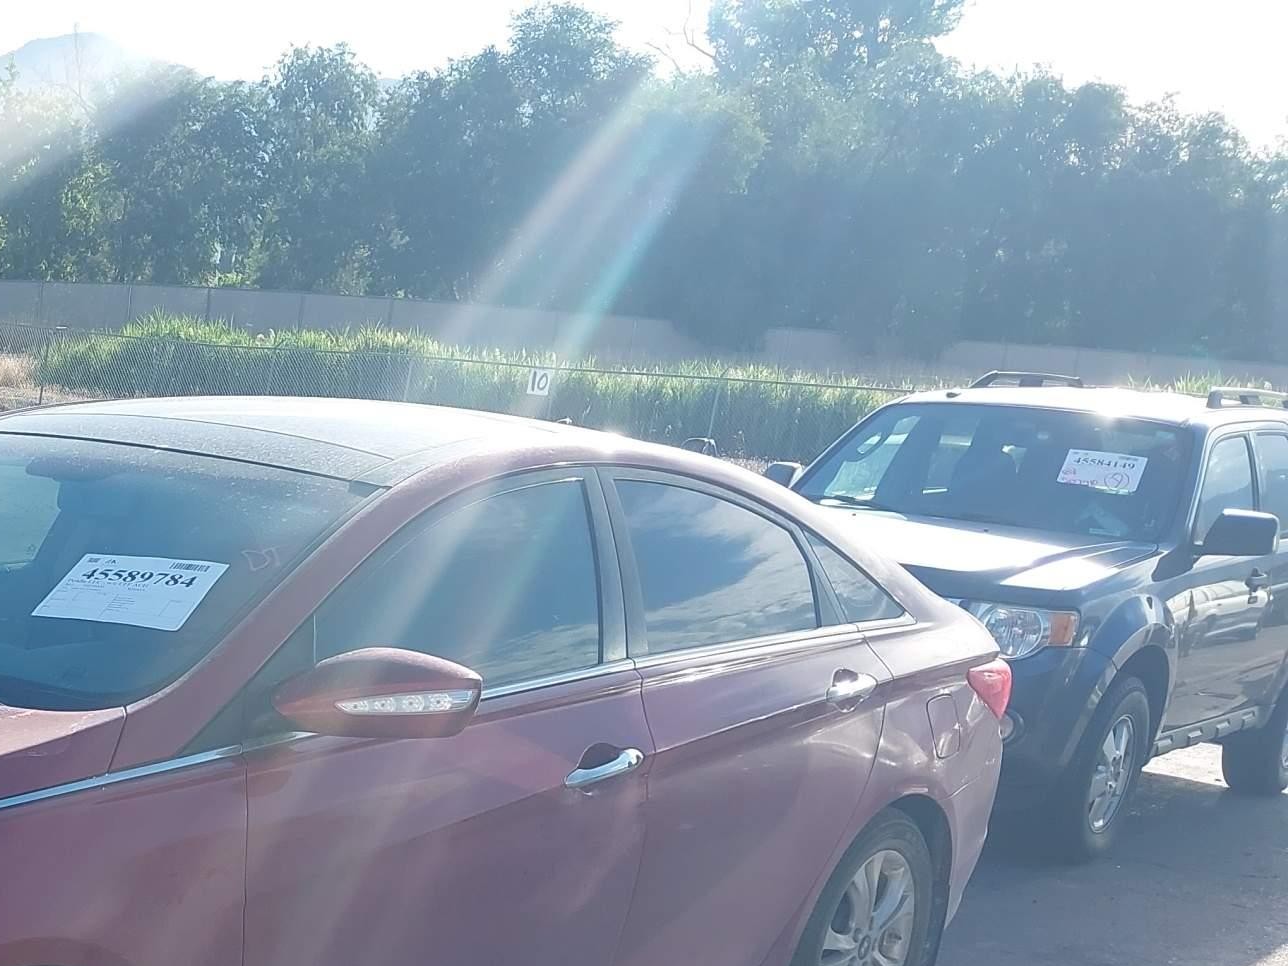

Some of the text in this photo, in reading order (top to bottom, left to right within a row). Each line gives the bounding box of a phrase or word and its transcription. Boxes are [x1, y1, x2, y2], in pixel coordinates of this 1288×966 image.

[531, 370, 549, 392] 10
[1073, 457, 1136, 469] 45584149
[82, 567, 198, 588] 45589784
